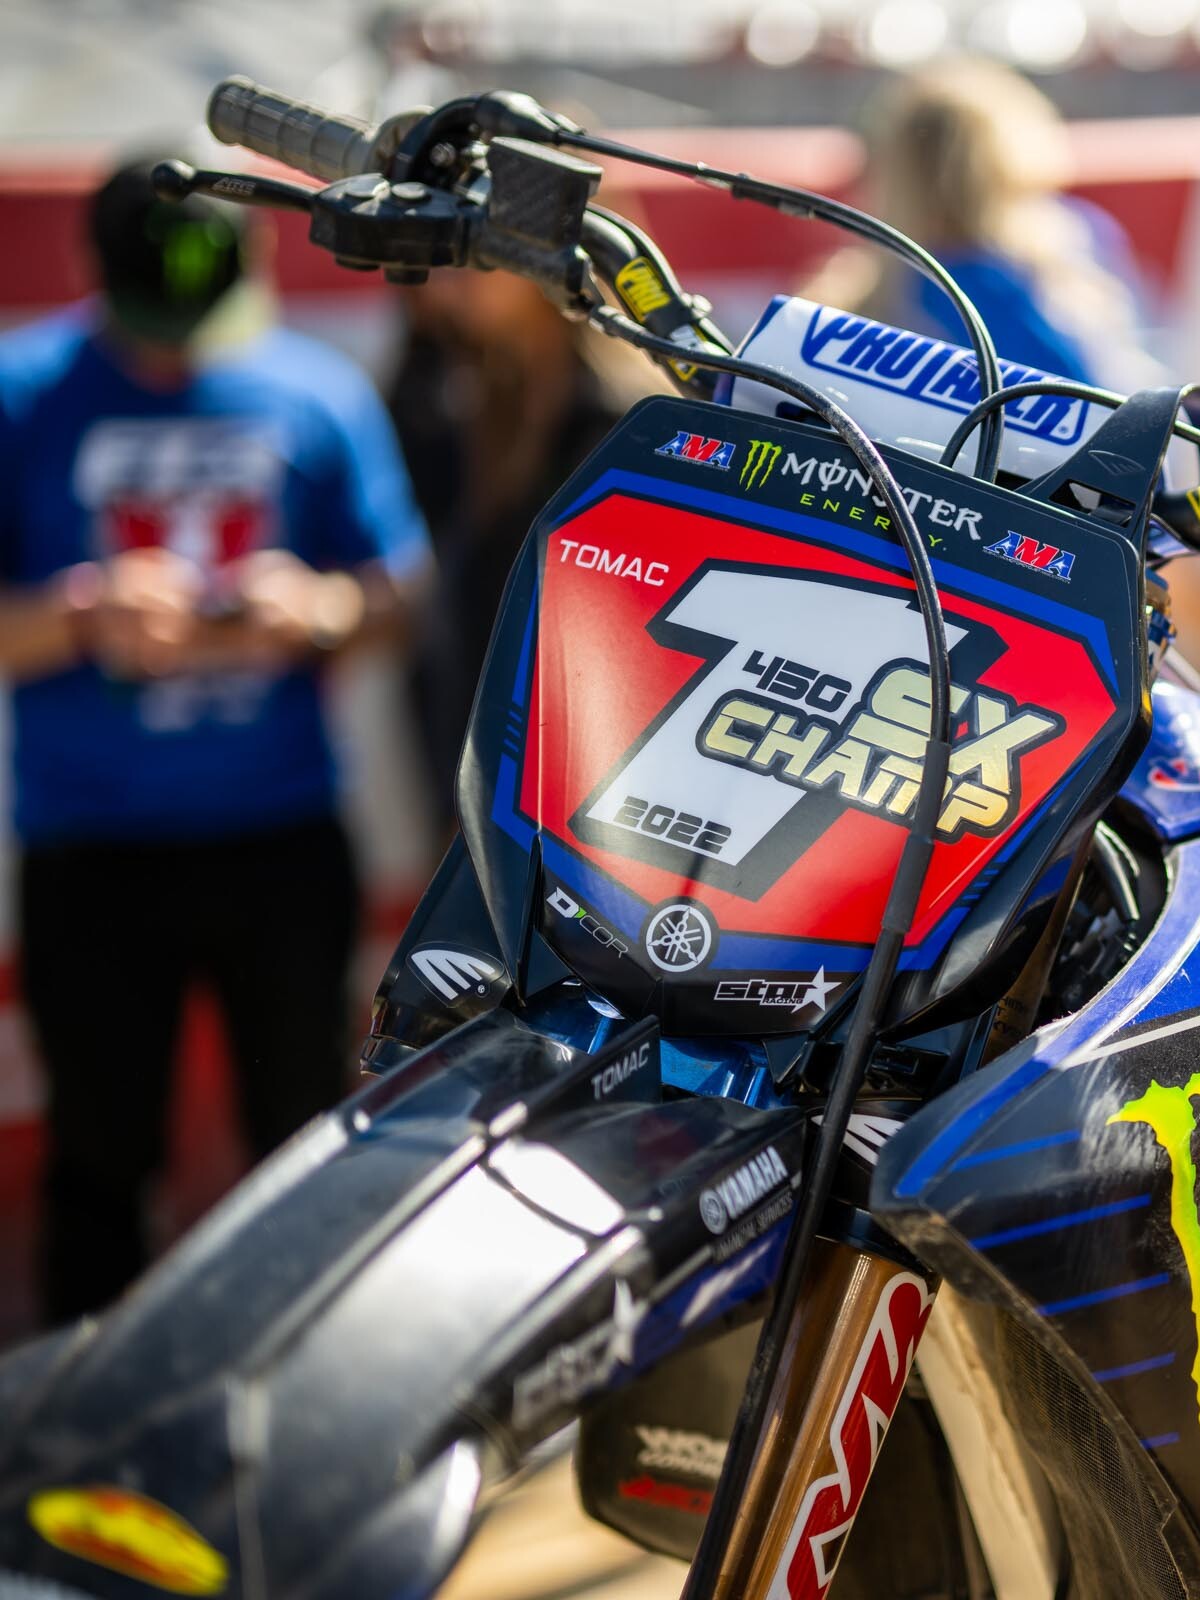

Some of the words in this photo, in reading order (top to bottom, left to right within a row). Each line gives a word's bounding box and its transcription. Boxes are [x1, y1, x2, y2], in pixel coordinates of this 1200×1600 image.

[654, 431, 736, 471] AMA
[800, 493, 944, 549] ENERY
[559, 539, 669, 587] TOMAC
[983, 530, 1076, 580] AMA
[742, 650, 852, 714] 450
[848, 668, 1056, 794] SX
[703, 699, 1011, 833] CHAMP
[613, 796, 732, 855] 2022
[761, 998, 805, 1006] RACING
[591, 1042, 650, 1100] TOMAC
[715, 1145, 788, 1220] YAMAHA
